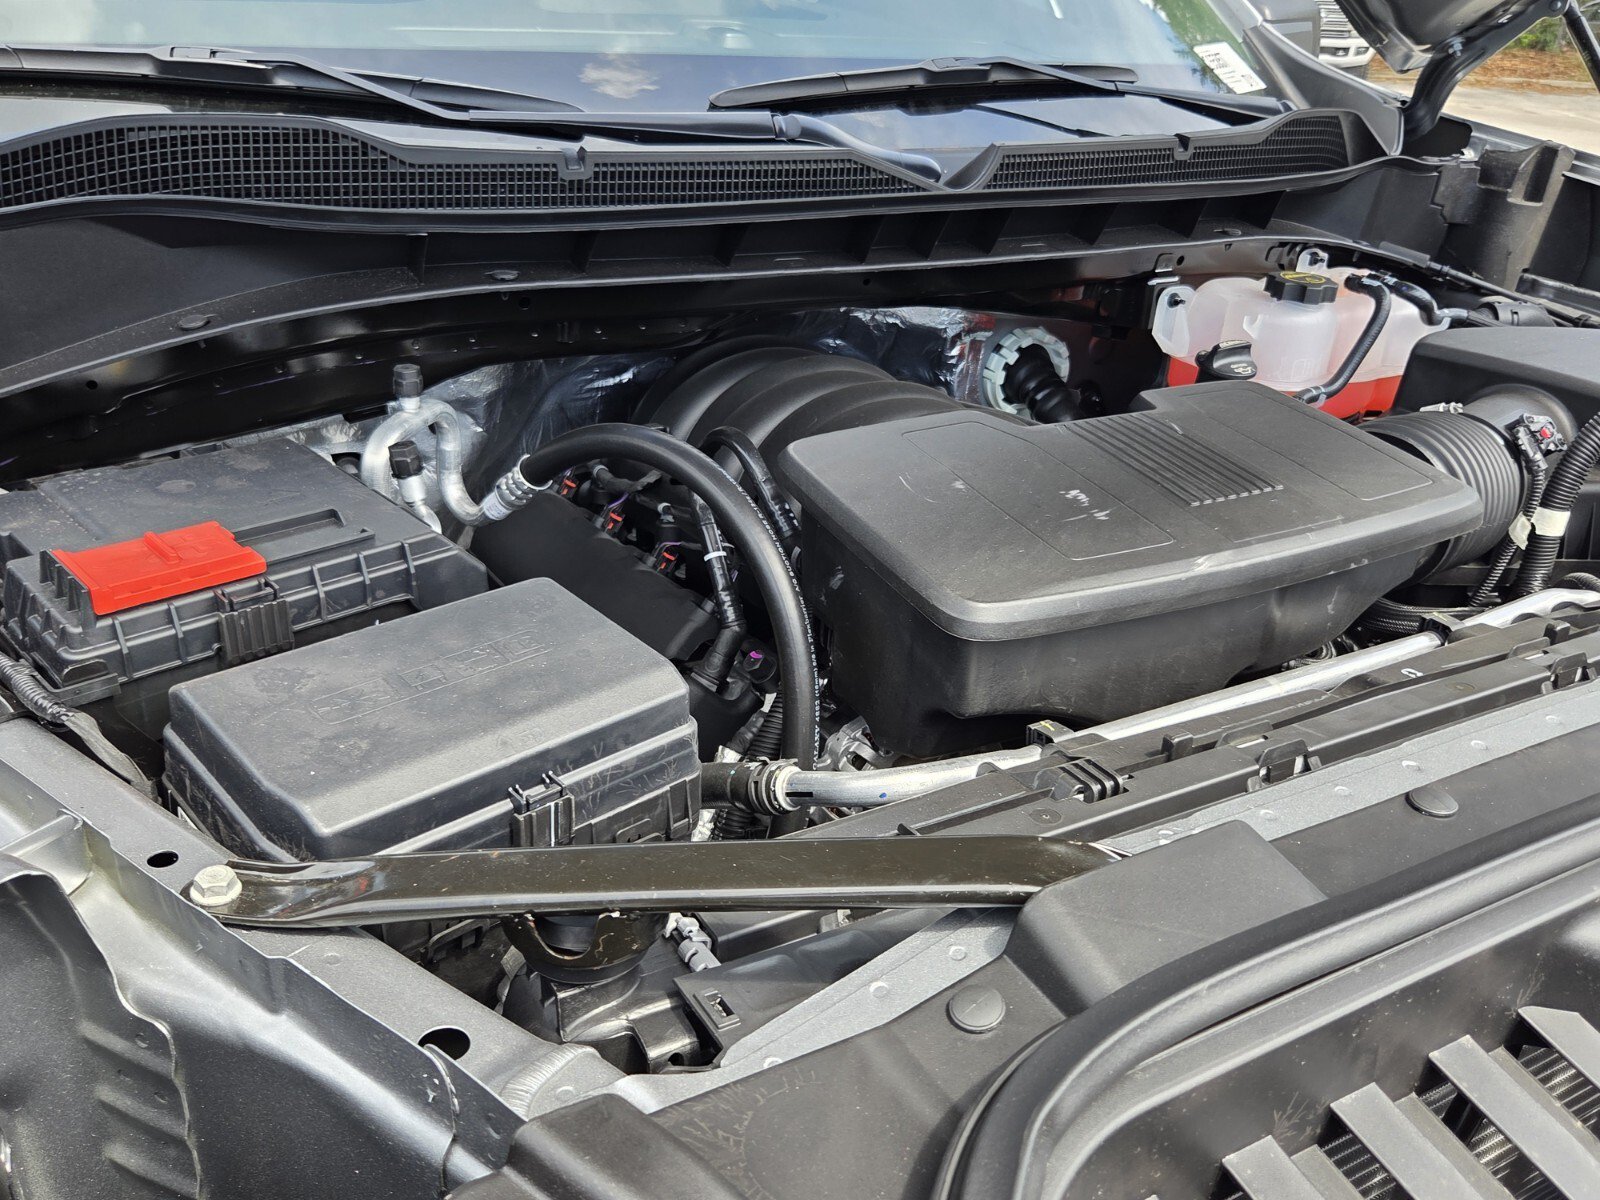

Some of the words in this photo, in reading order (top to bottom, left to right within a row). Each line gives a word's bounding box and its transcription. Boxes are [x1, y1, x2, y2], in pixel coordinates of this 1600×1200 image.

[763, 520, 778, 541] HOSE
[775, 541, 795, 577] SUCTION
[812, 725, 820, 770] GALAXY
